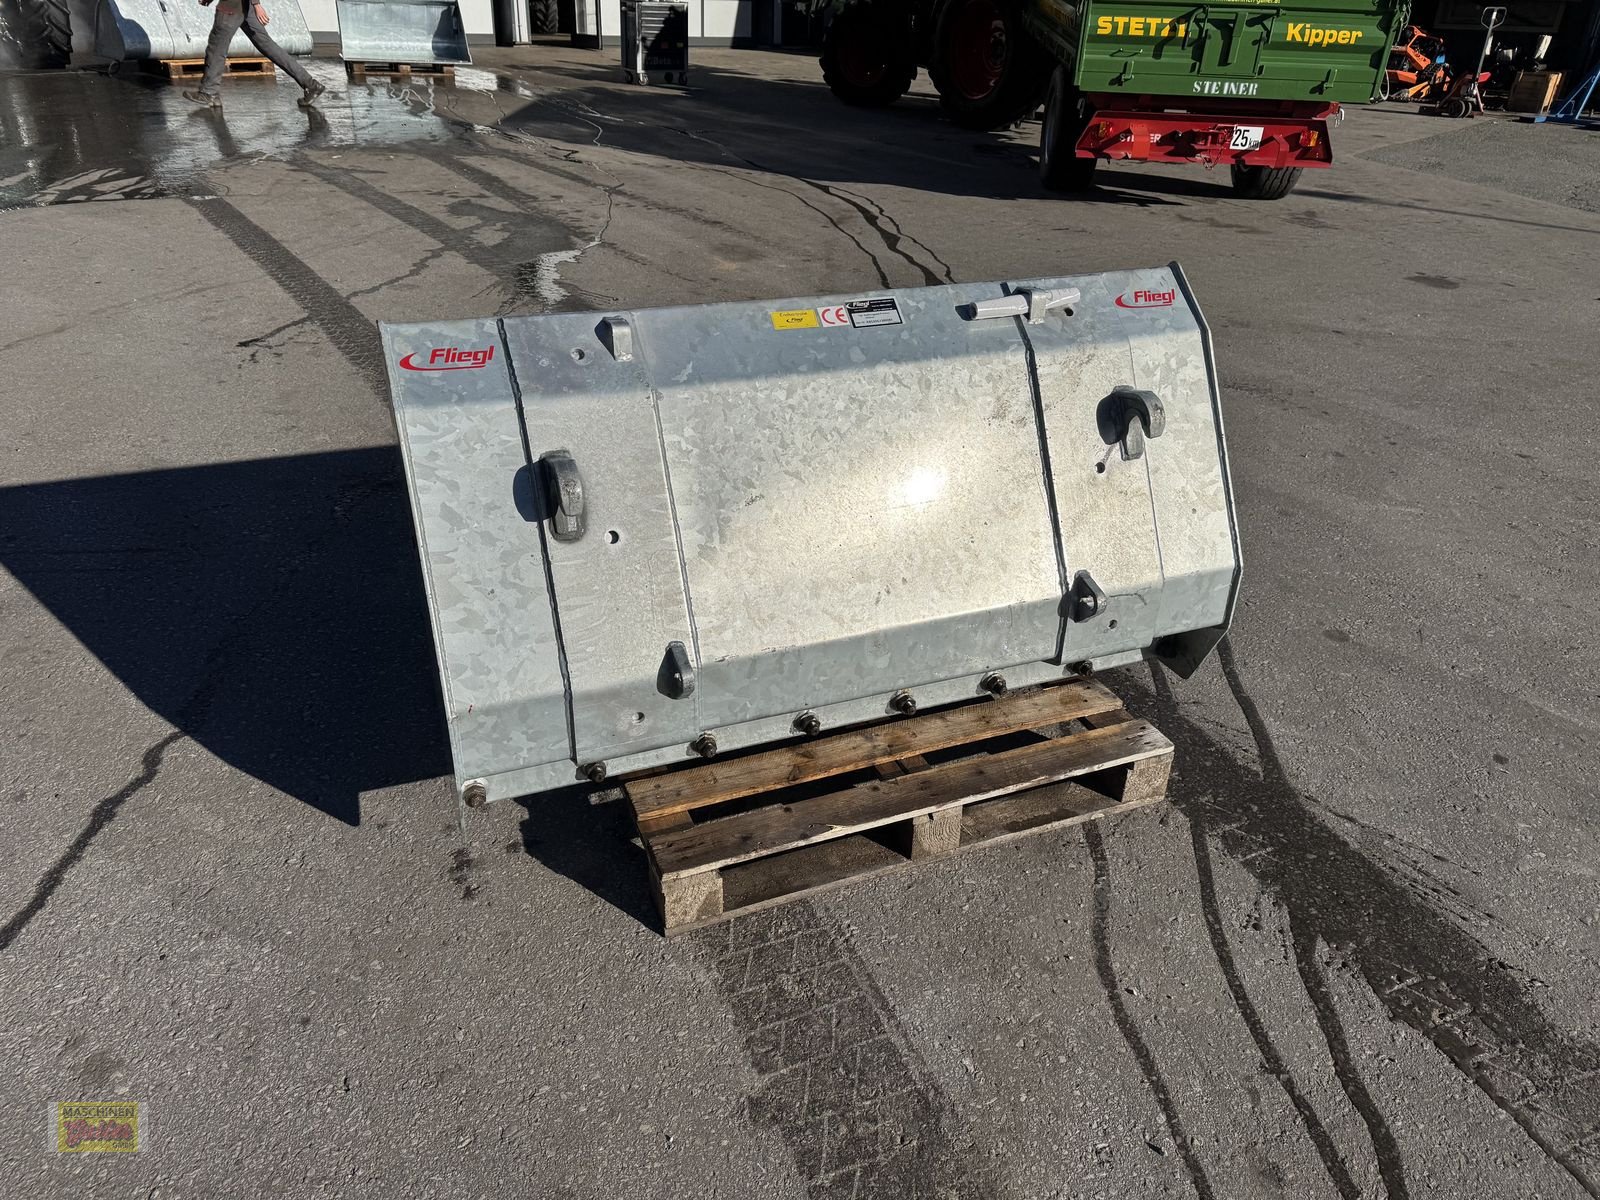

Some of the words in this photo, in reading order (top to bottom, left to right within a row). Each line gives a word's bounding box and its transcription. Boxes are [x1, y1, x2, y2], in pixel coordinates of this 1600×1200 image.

[1286, 22, 1363, 47] Kipper
[1192, 79, 1259, 97] STEINER
[1231, 128, 1250, 148] 25
[1133, 288, 1176, 304] Fliegl
[821, 307, 849, 325] CE
[429, 345, 495, 366] Fliegl
